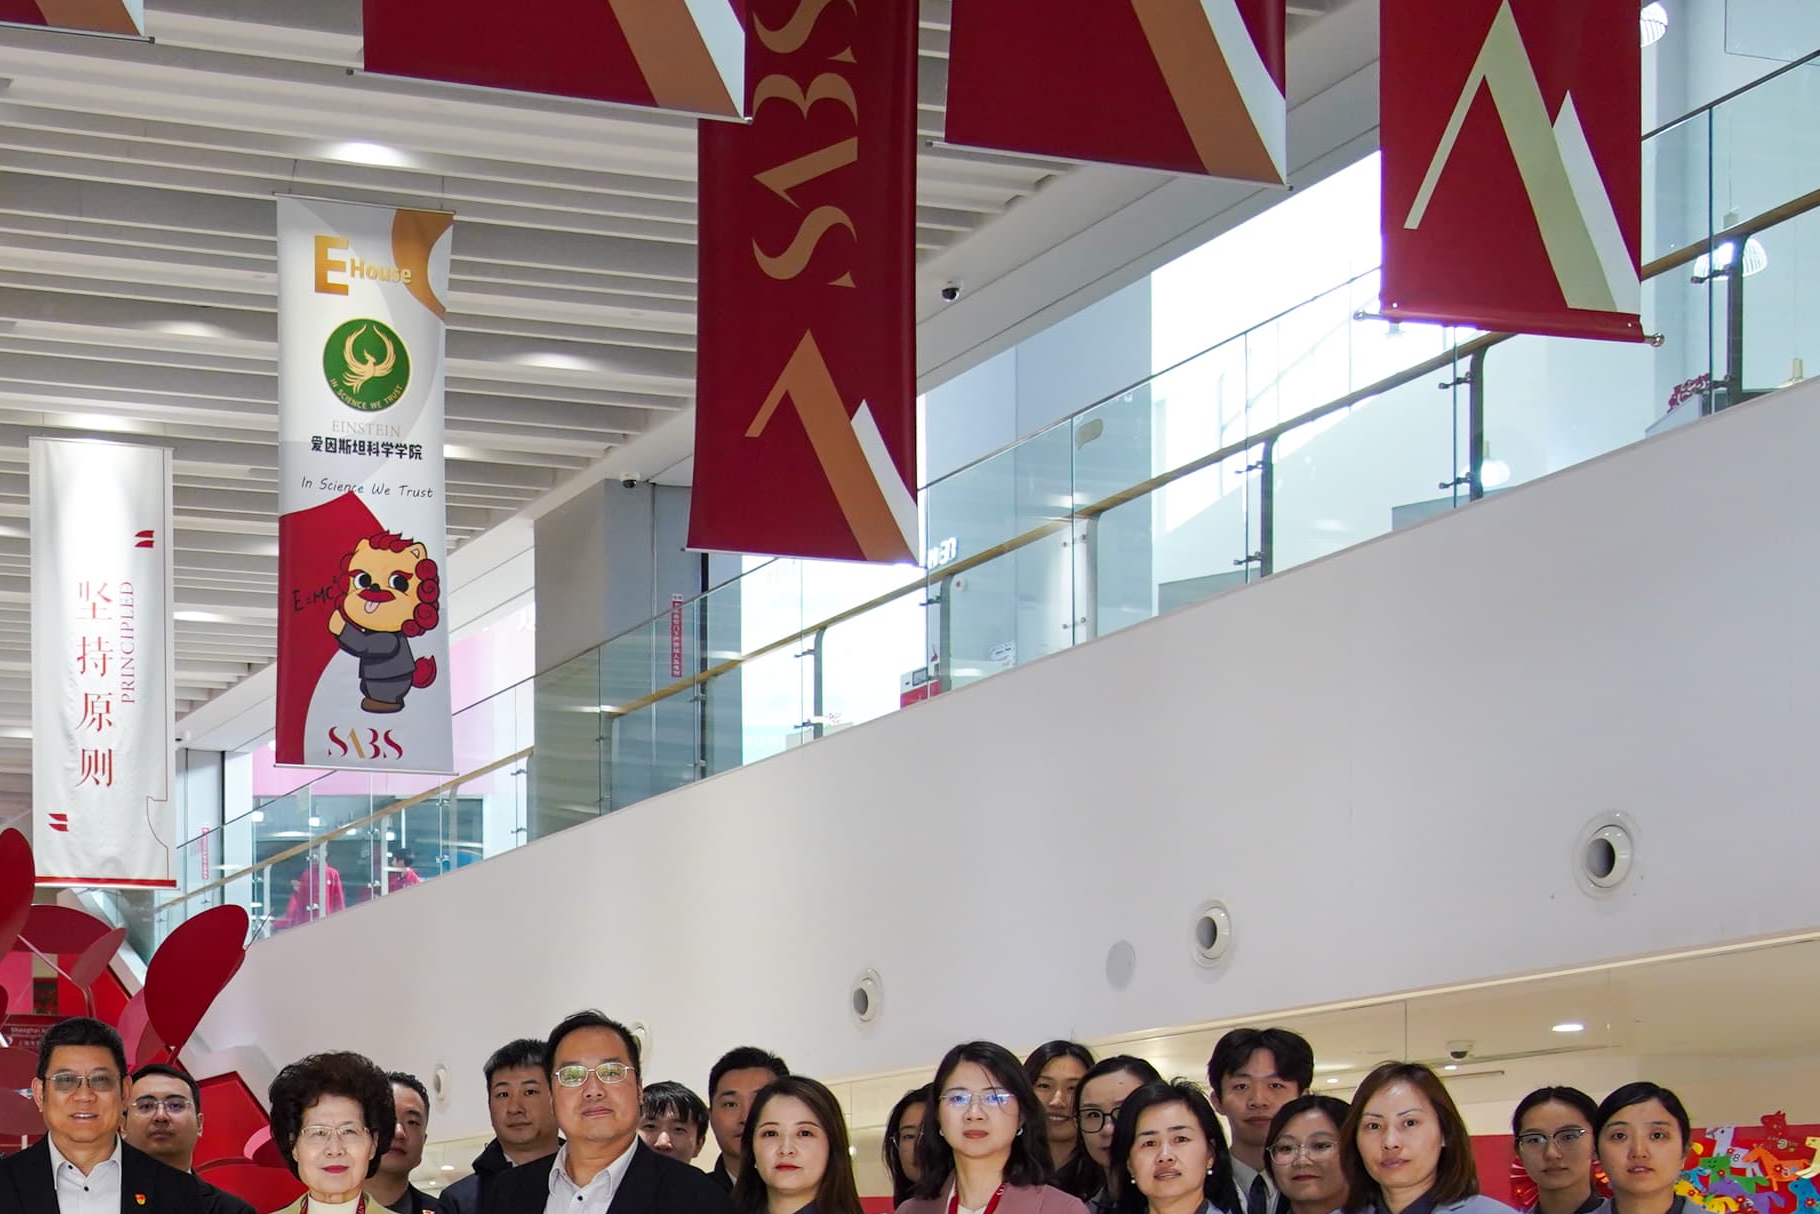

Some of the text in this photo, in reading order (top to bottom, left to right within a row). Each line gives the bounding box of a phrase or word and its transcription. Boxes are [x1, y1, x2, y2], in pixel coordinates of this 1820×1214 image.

[314, 235, 412, 296] E House
[337, 388, 367, 409] SCIENCE
[384, 384, 403, 404] TRUST
[332, 420, 402, 438] EINSTEIN
[311, 435, 423, 460] 爱因斯坦科学学院
[301, 475, 433, 498] In Science We Trust
[120, 580, 136, 704] PRINCIPLED
[75, 579, 115, 789] 坚持原则
[328, 726, 404, 760] SABS
